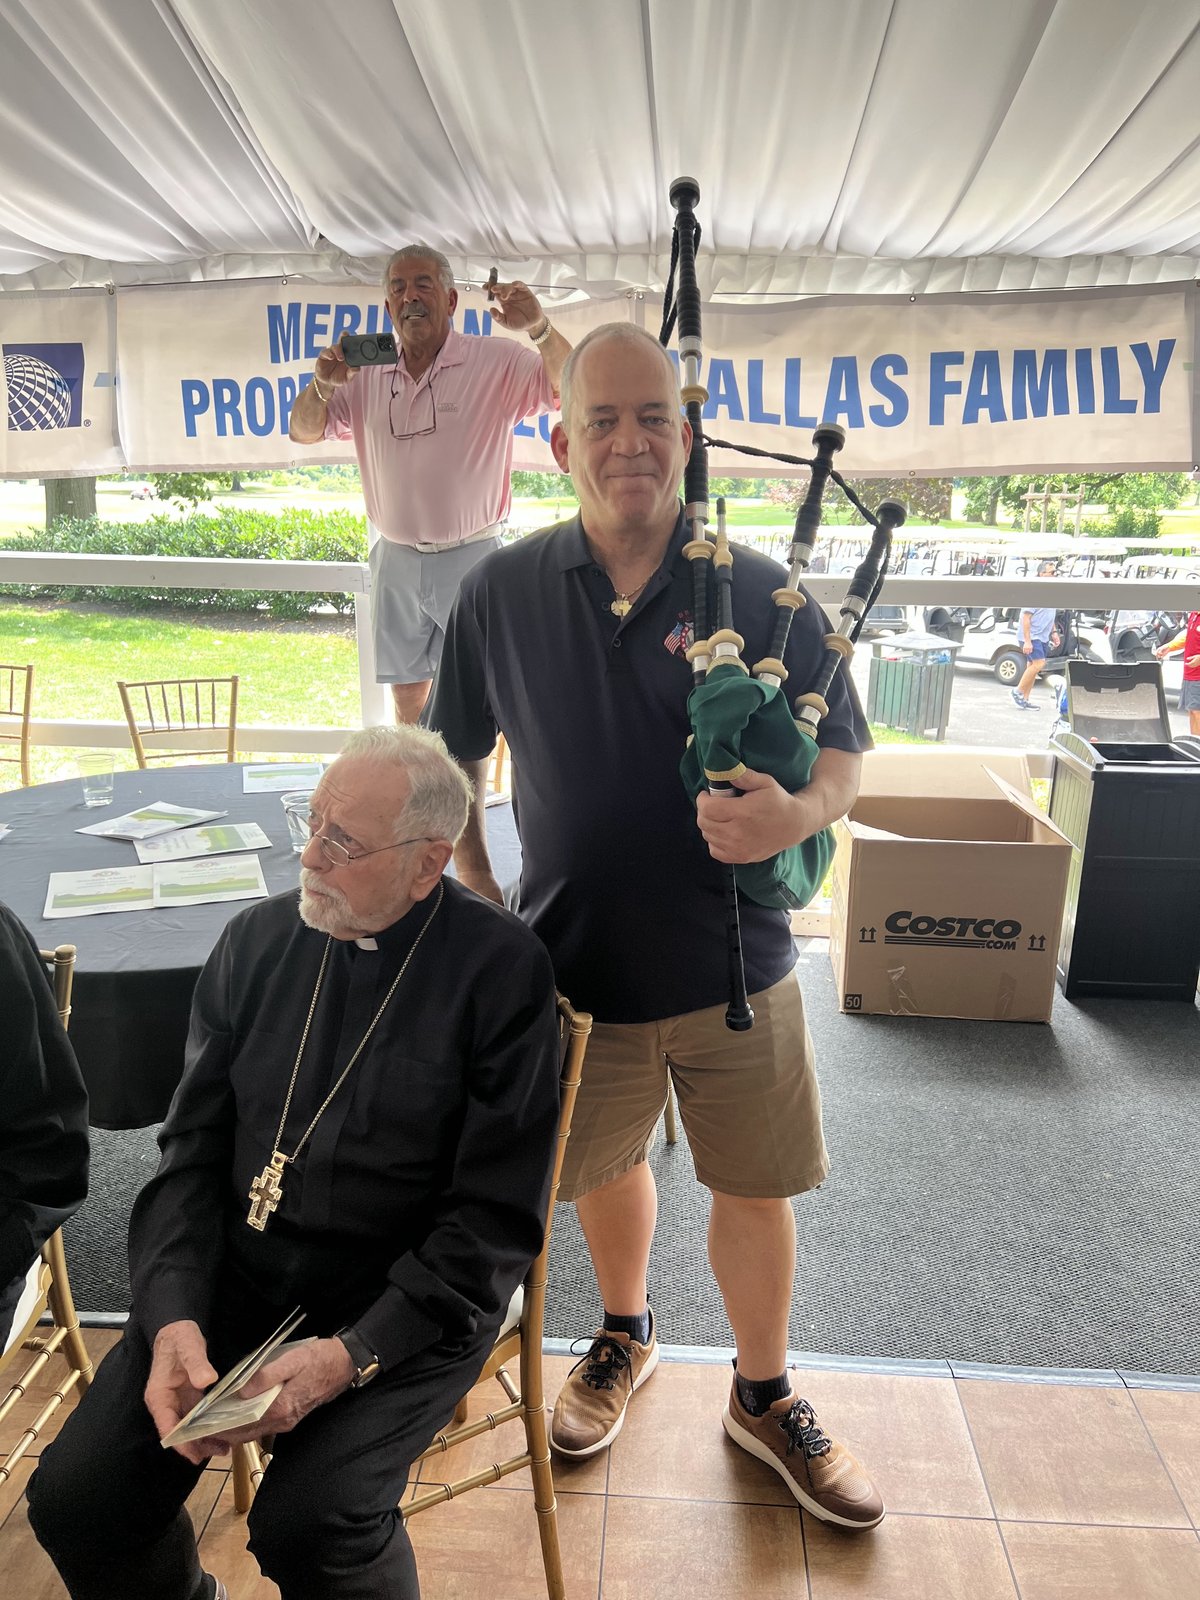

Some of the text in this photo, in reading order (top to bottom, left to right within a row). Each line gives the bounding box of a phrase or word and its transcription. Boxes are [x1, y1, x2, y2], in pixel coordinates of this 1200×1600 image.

[929, 340, 1173, 426] FAMILY
[885, 911, 1022, 940] COSTCO
[845, 996, 861, 1008] 50
